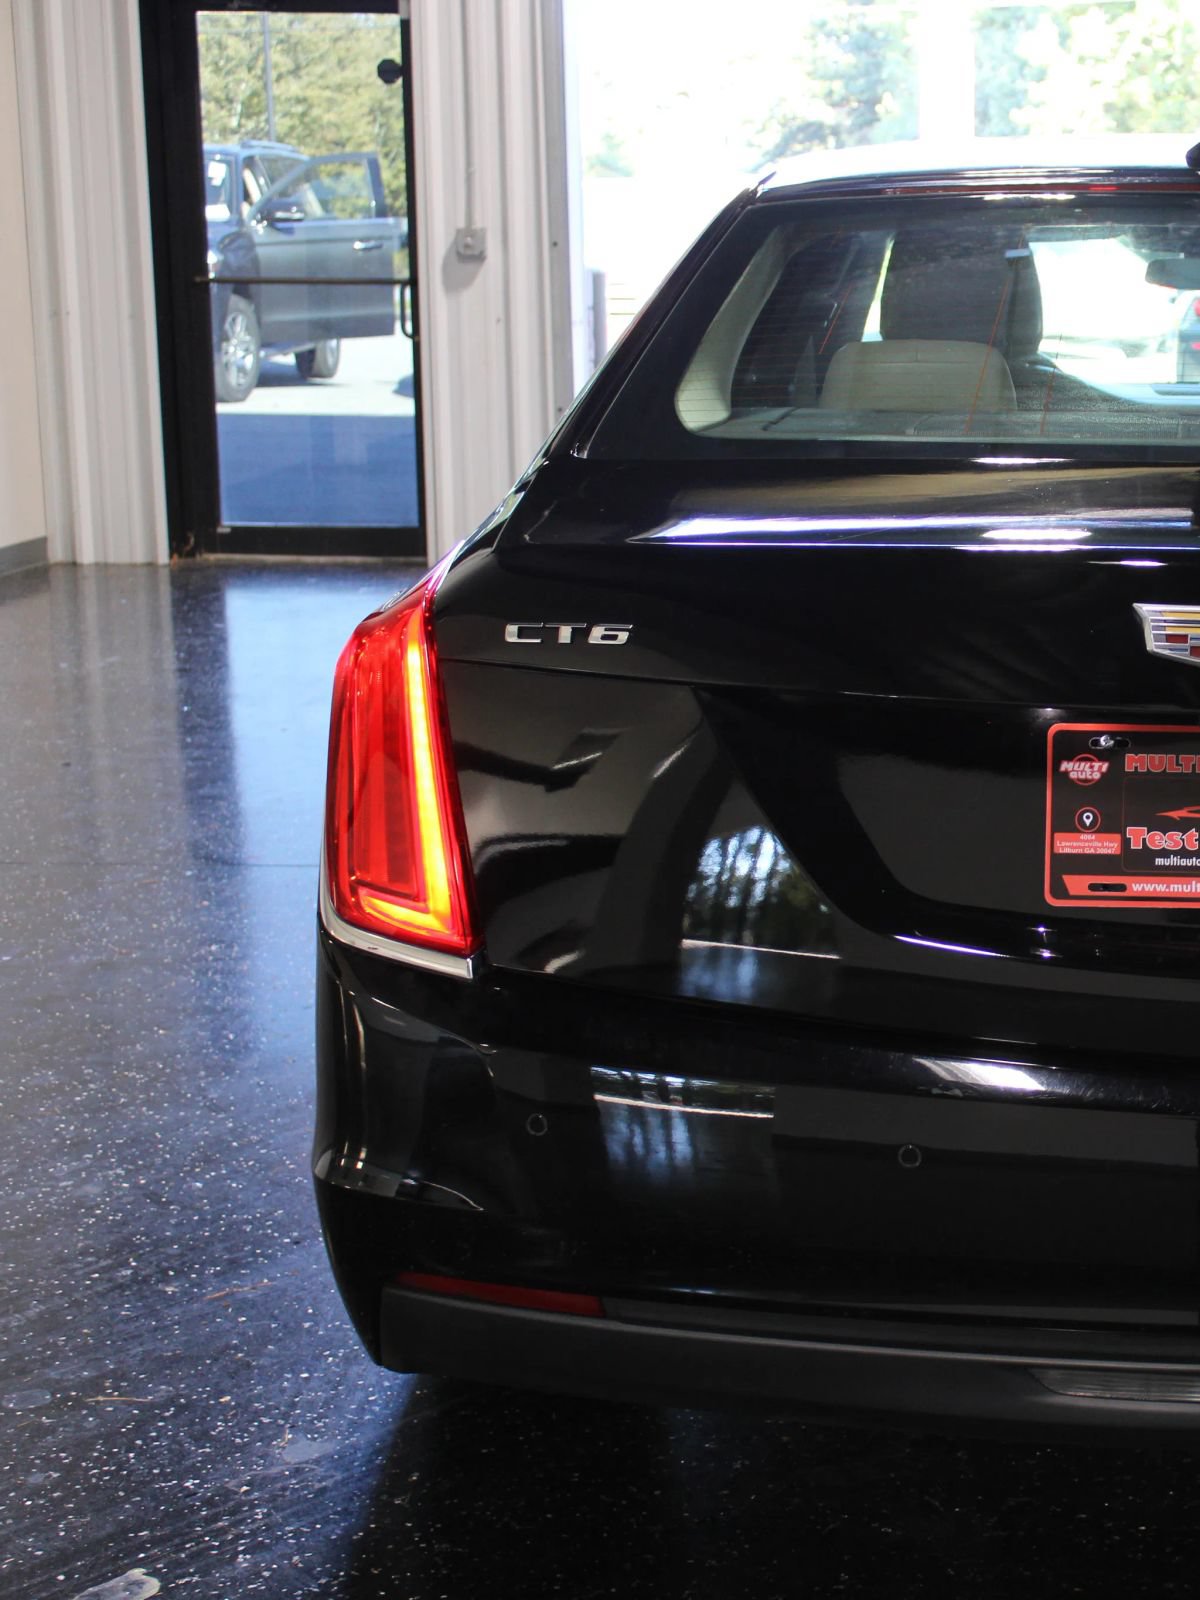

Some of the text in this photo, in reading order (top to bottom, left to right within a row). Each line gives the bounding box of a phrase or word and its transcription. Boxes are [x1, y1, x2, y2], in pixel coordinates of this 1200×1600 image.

[504, 622, 633, 645] CT6
[1060, 760, 1109, 772] MULTI
[1069, 769, 1101, 779] auto
[1104, 840, 1118, 848] Hwy
[1126, 826, 1199, 850] Test
